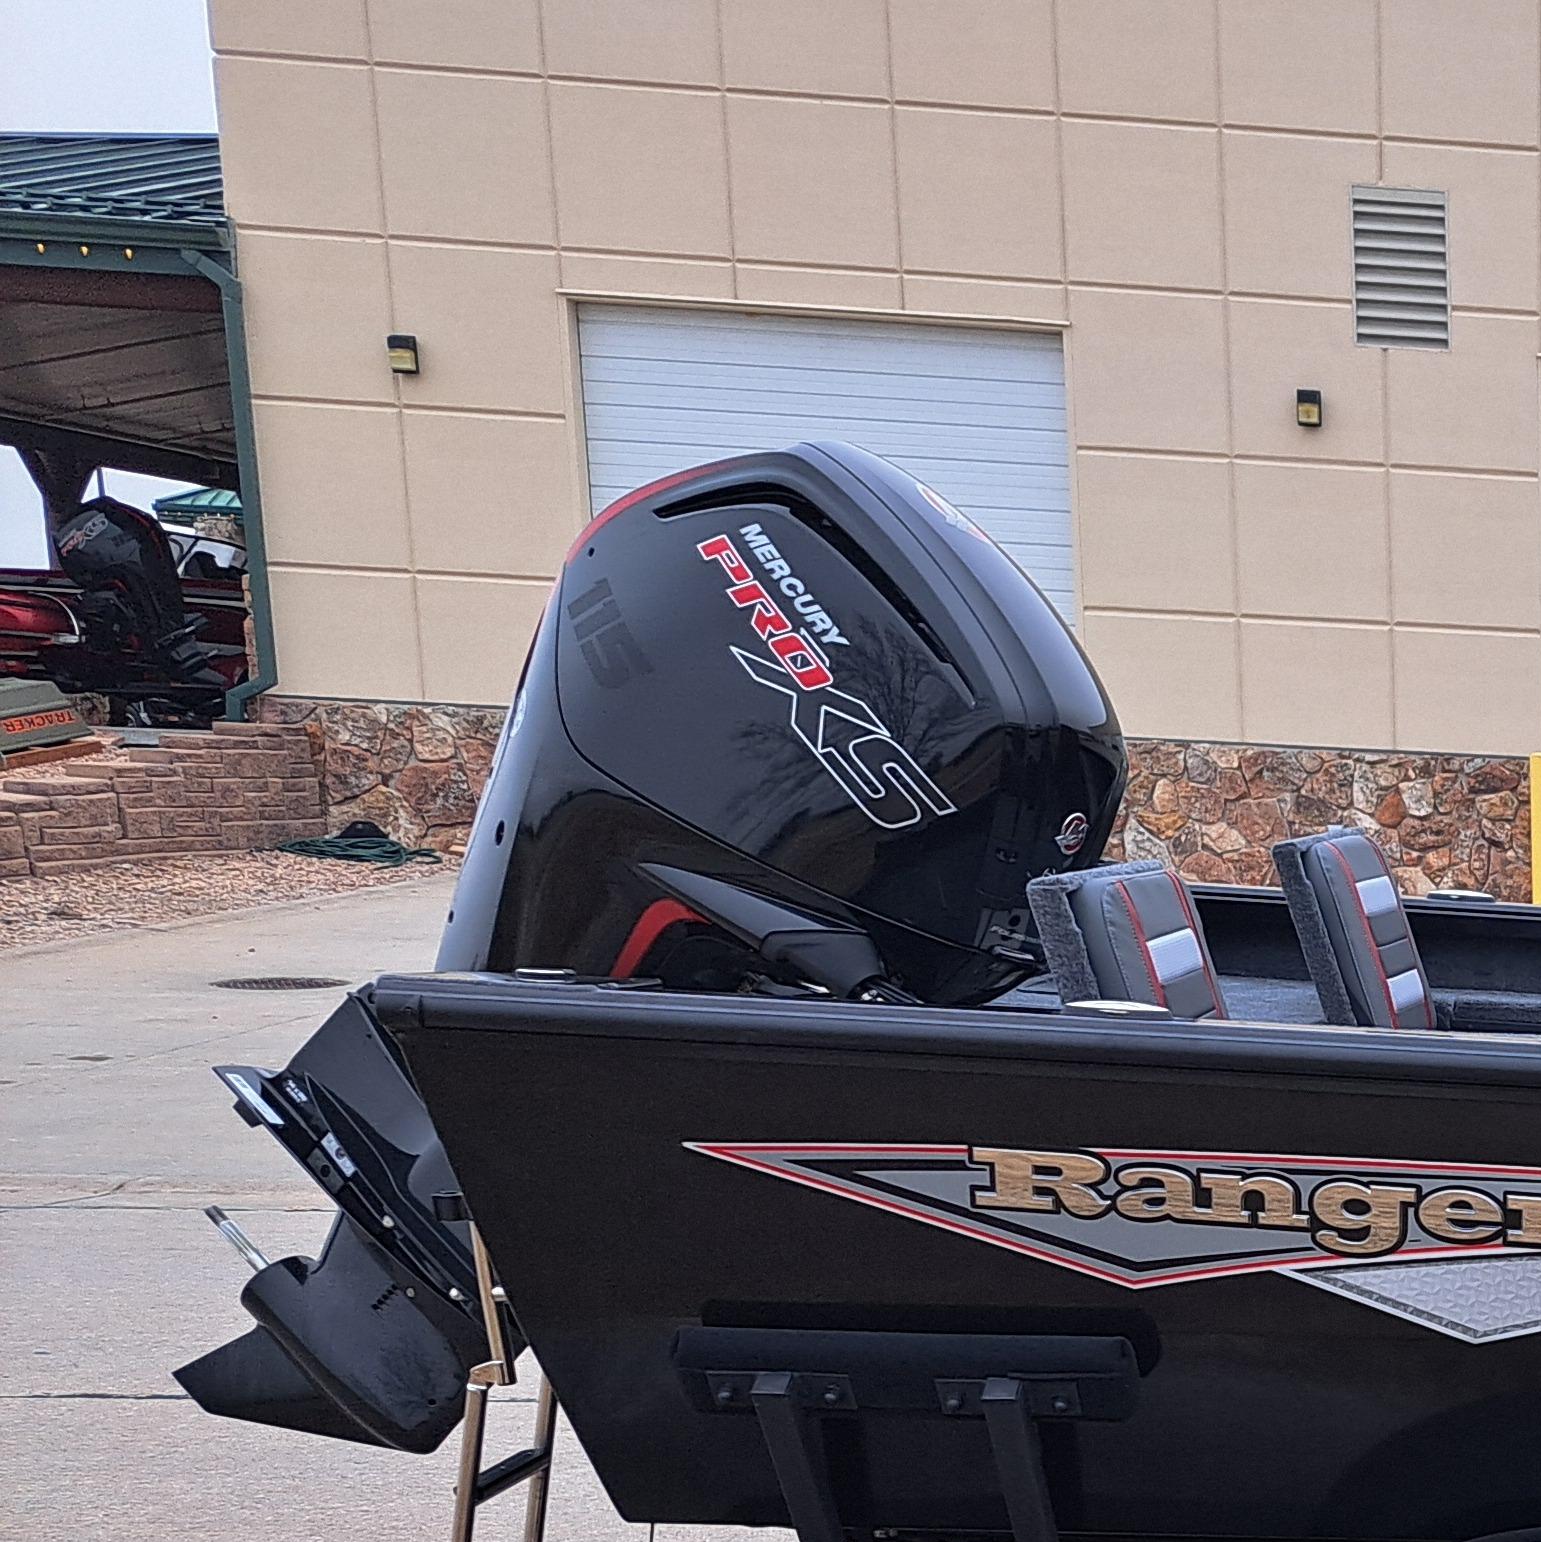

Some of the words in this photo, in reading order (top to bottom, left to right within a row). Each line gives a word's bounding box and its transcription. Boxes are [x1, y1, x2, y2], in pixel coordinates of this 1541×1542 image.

[566, 576, 657, 690] 115
[696, 533, 834, 691] PRO
[739, 522, 850, 647] MERCURY
[2, 708, 76, 733] TRACKER
[728, 645, 959, 830] XS
